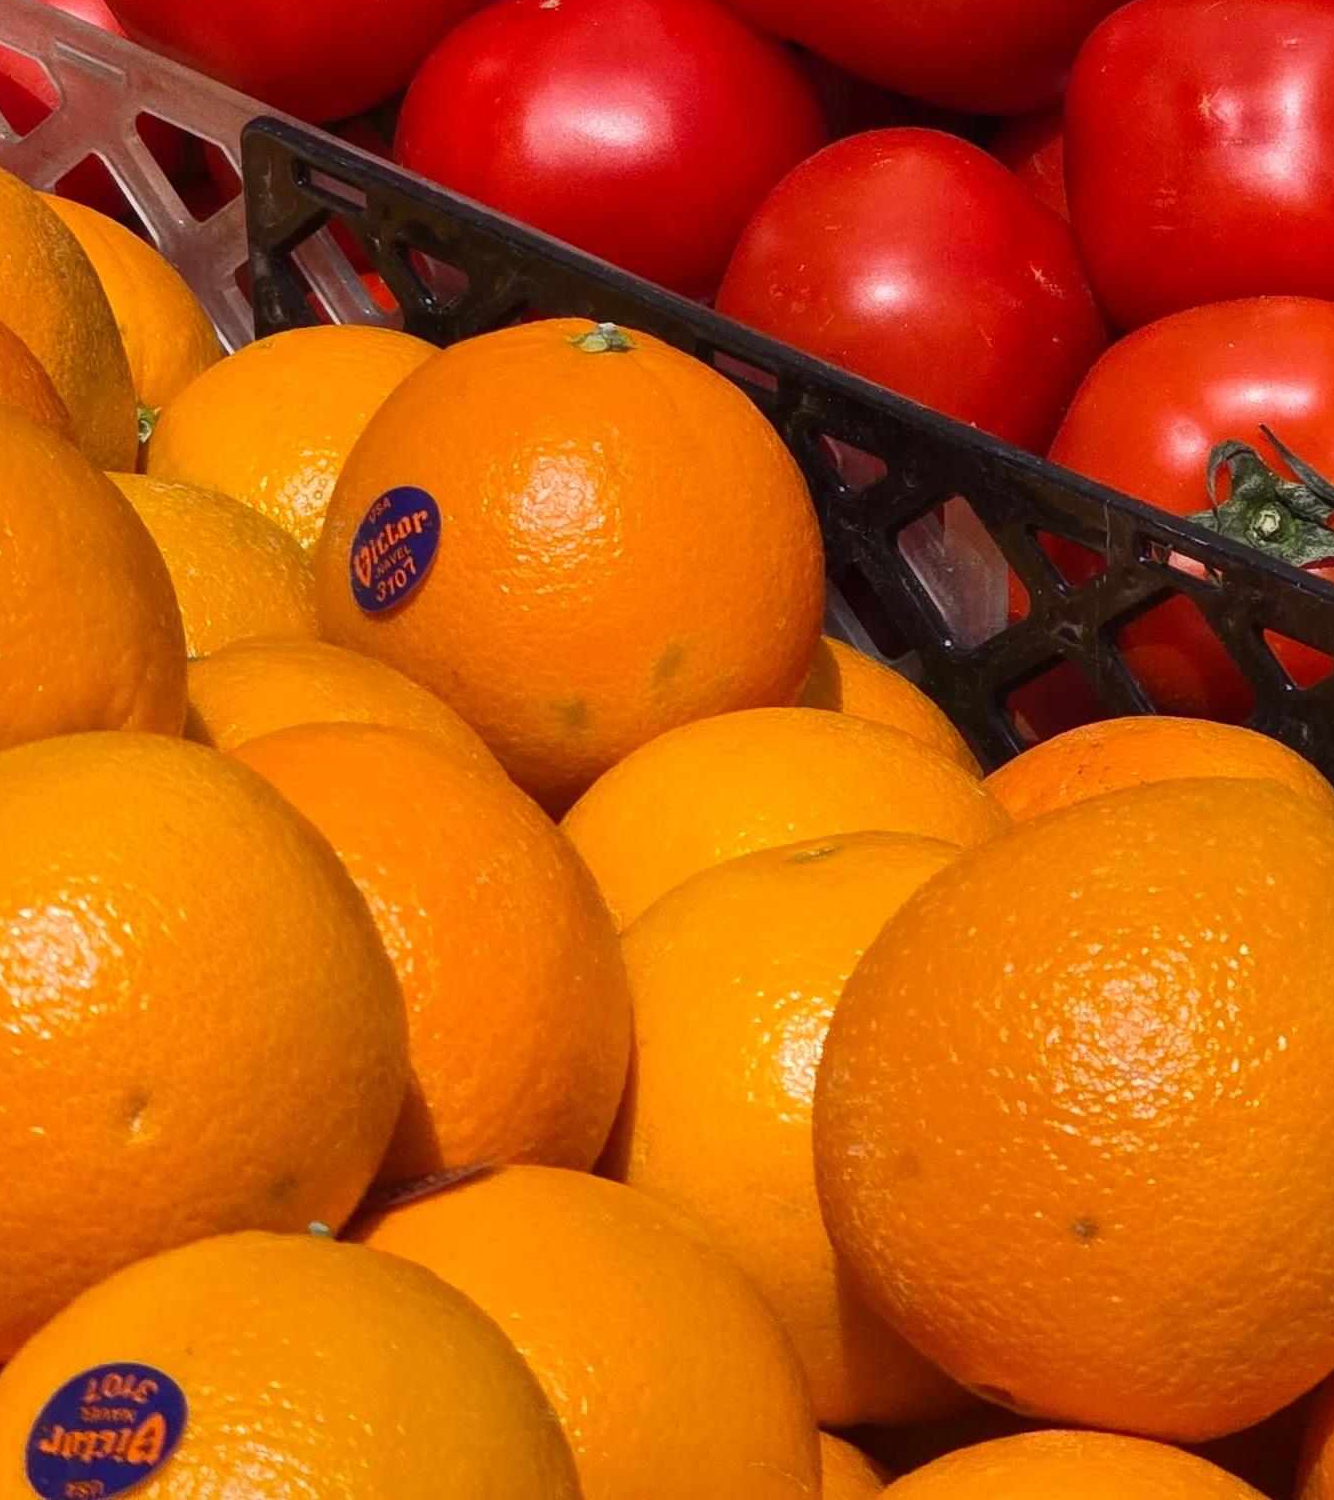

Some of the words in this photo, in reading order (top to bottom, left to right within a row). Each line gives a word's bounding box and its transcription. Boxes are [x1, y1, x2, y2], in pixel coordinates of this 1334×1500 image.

[368, 497, 392, 524] USA
[354, 509, 428, 589] Victor
[377, 544, 412, 576] NAVEL
[376, 556, 416, 602] 3107
[82, 1372, 159, 1404] 3107
[39, 1412, 166, 1466] Victor
